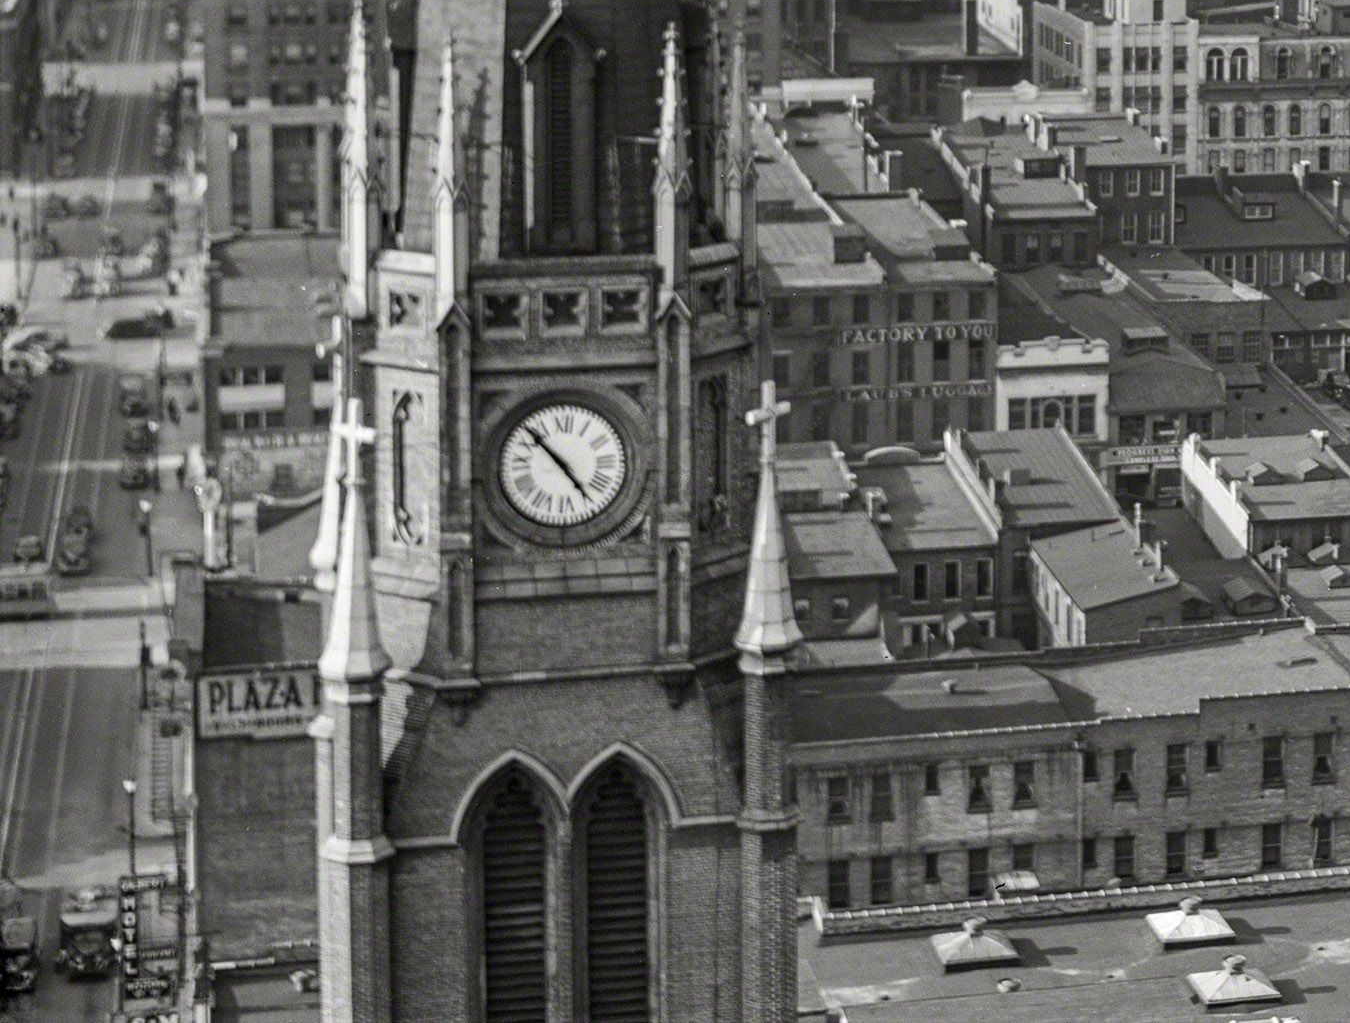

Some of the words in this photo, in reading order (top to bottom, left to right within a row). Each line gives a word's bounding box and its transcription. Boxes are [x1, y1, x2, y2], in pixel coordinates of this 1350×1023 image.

[842, 328, 928, 343] FACTORY
[935, 327, 957, 340] TO
[961, 324, 994, 339] YOU
[208, 676, 303, 714] PLAZA
[121, 895, 138, 976] HOTEL
